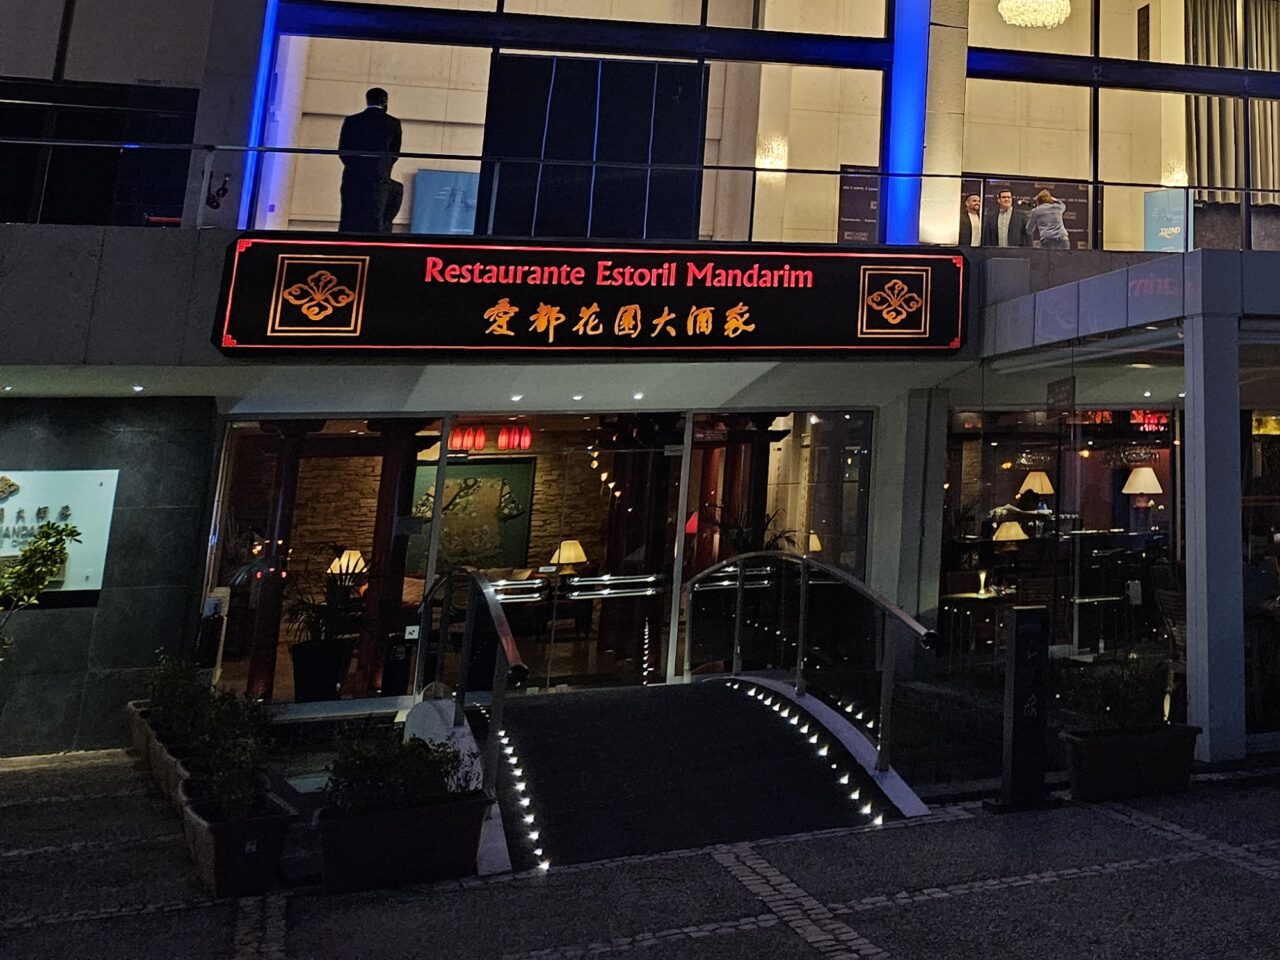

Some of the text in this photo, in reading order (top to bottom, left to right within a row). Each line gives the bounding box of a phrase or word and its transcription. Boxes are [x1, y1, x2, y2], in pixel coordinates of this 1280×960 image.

[424, 256, 814, 288] Restaurante Estoril Mandarim
